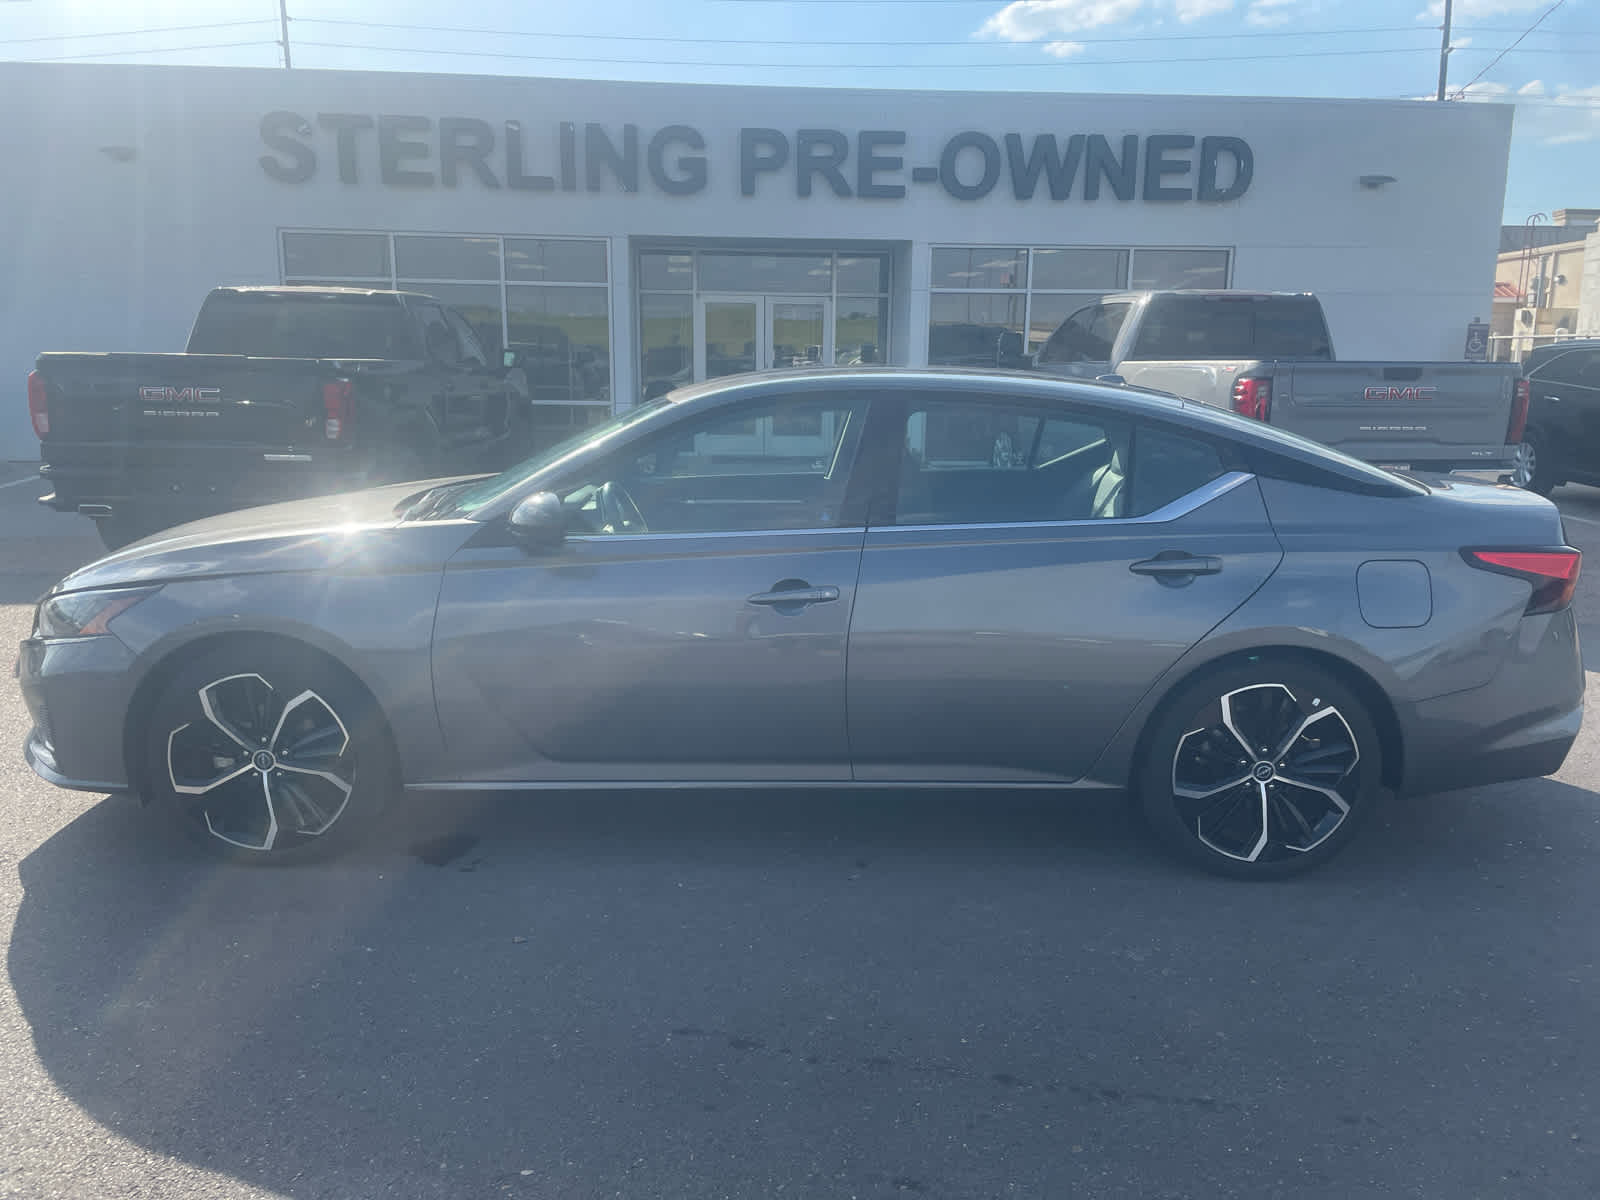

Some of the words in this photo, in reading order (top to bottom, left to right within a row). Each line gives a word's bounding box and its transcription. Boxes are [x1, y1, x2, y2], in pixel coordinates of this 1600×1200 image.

[258, 110, 709, 197] STERLING
[739, 127, 1255, 203] PRE-OWNED
[139, 386, 221, 401] GMC
[1364, 386, 1438, 401] GMC
